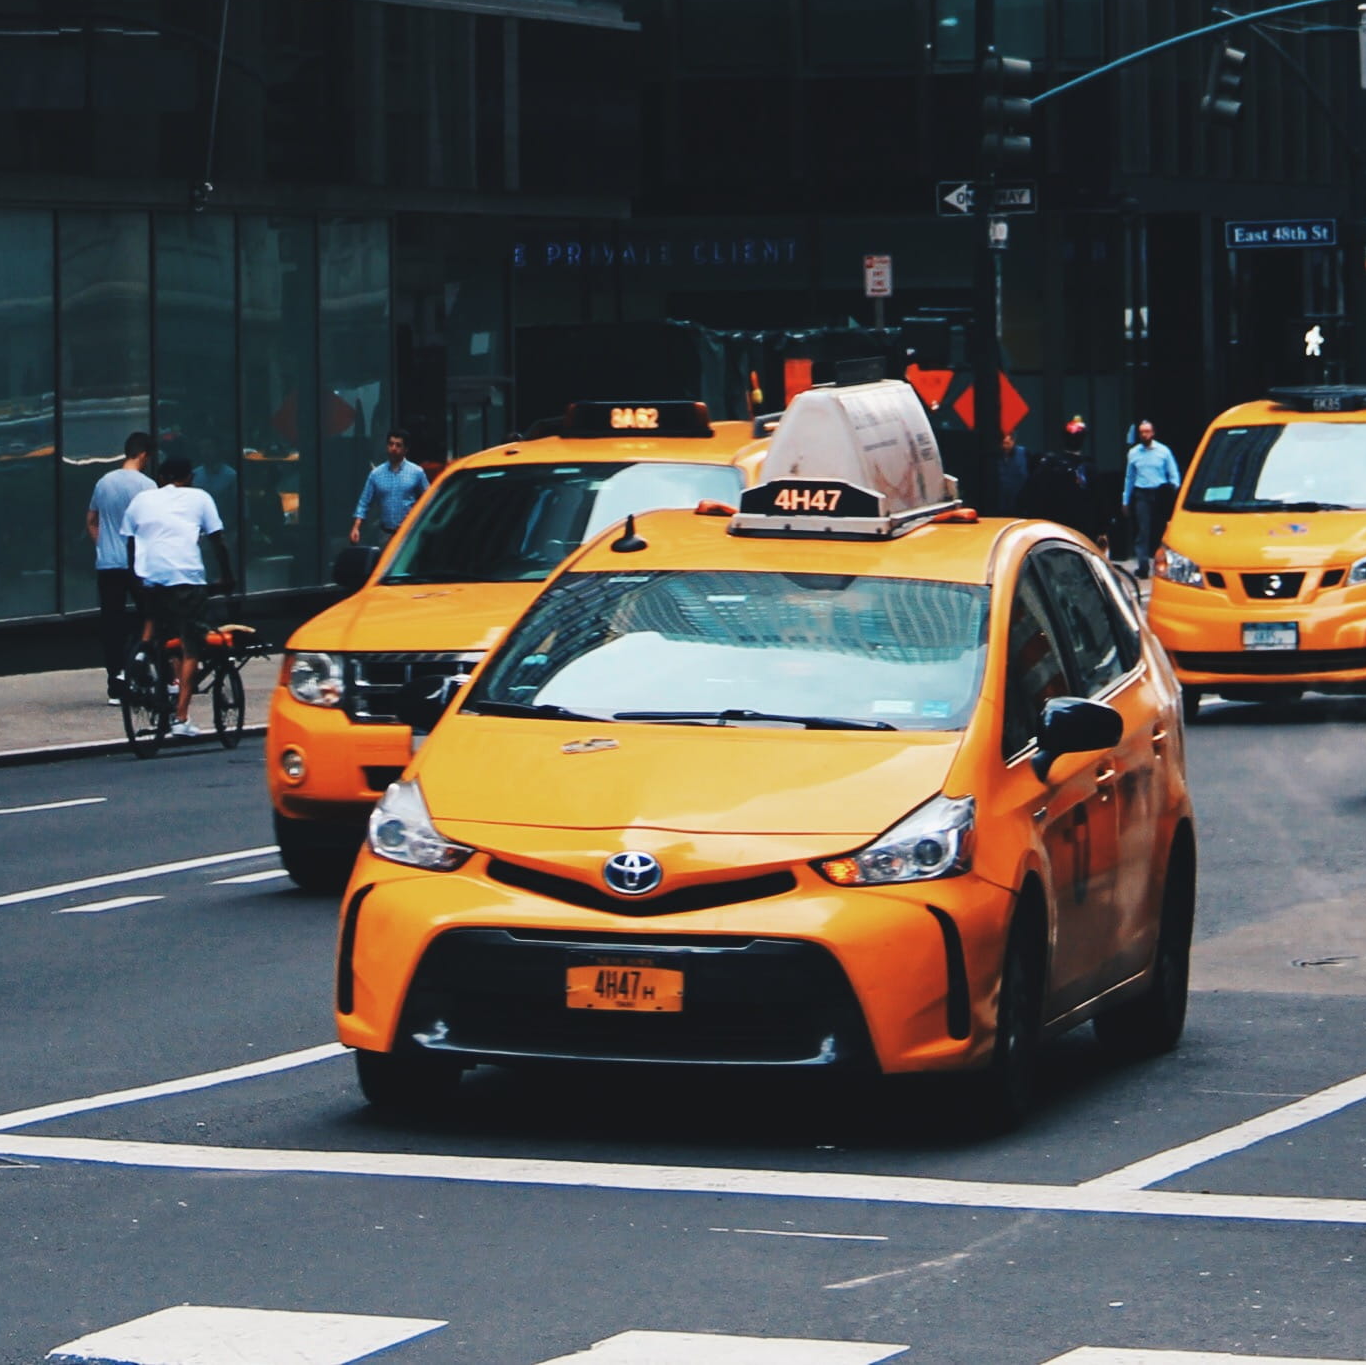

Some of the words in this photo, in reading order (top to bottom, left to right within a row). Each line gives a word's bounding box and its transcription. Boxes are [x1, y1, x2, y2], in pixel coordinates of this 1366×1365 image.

[1234, 227, 1268, 242] East
[1272, 226, 1307, 241] 48th
[1311, 225, 1329, 240] St
[691, 239, 796, 267] CLIENT
[773, 489, 843, 512] 4H47
